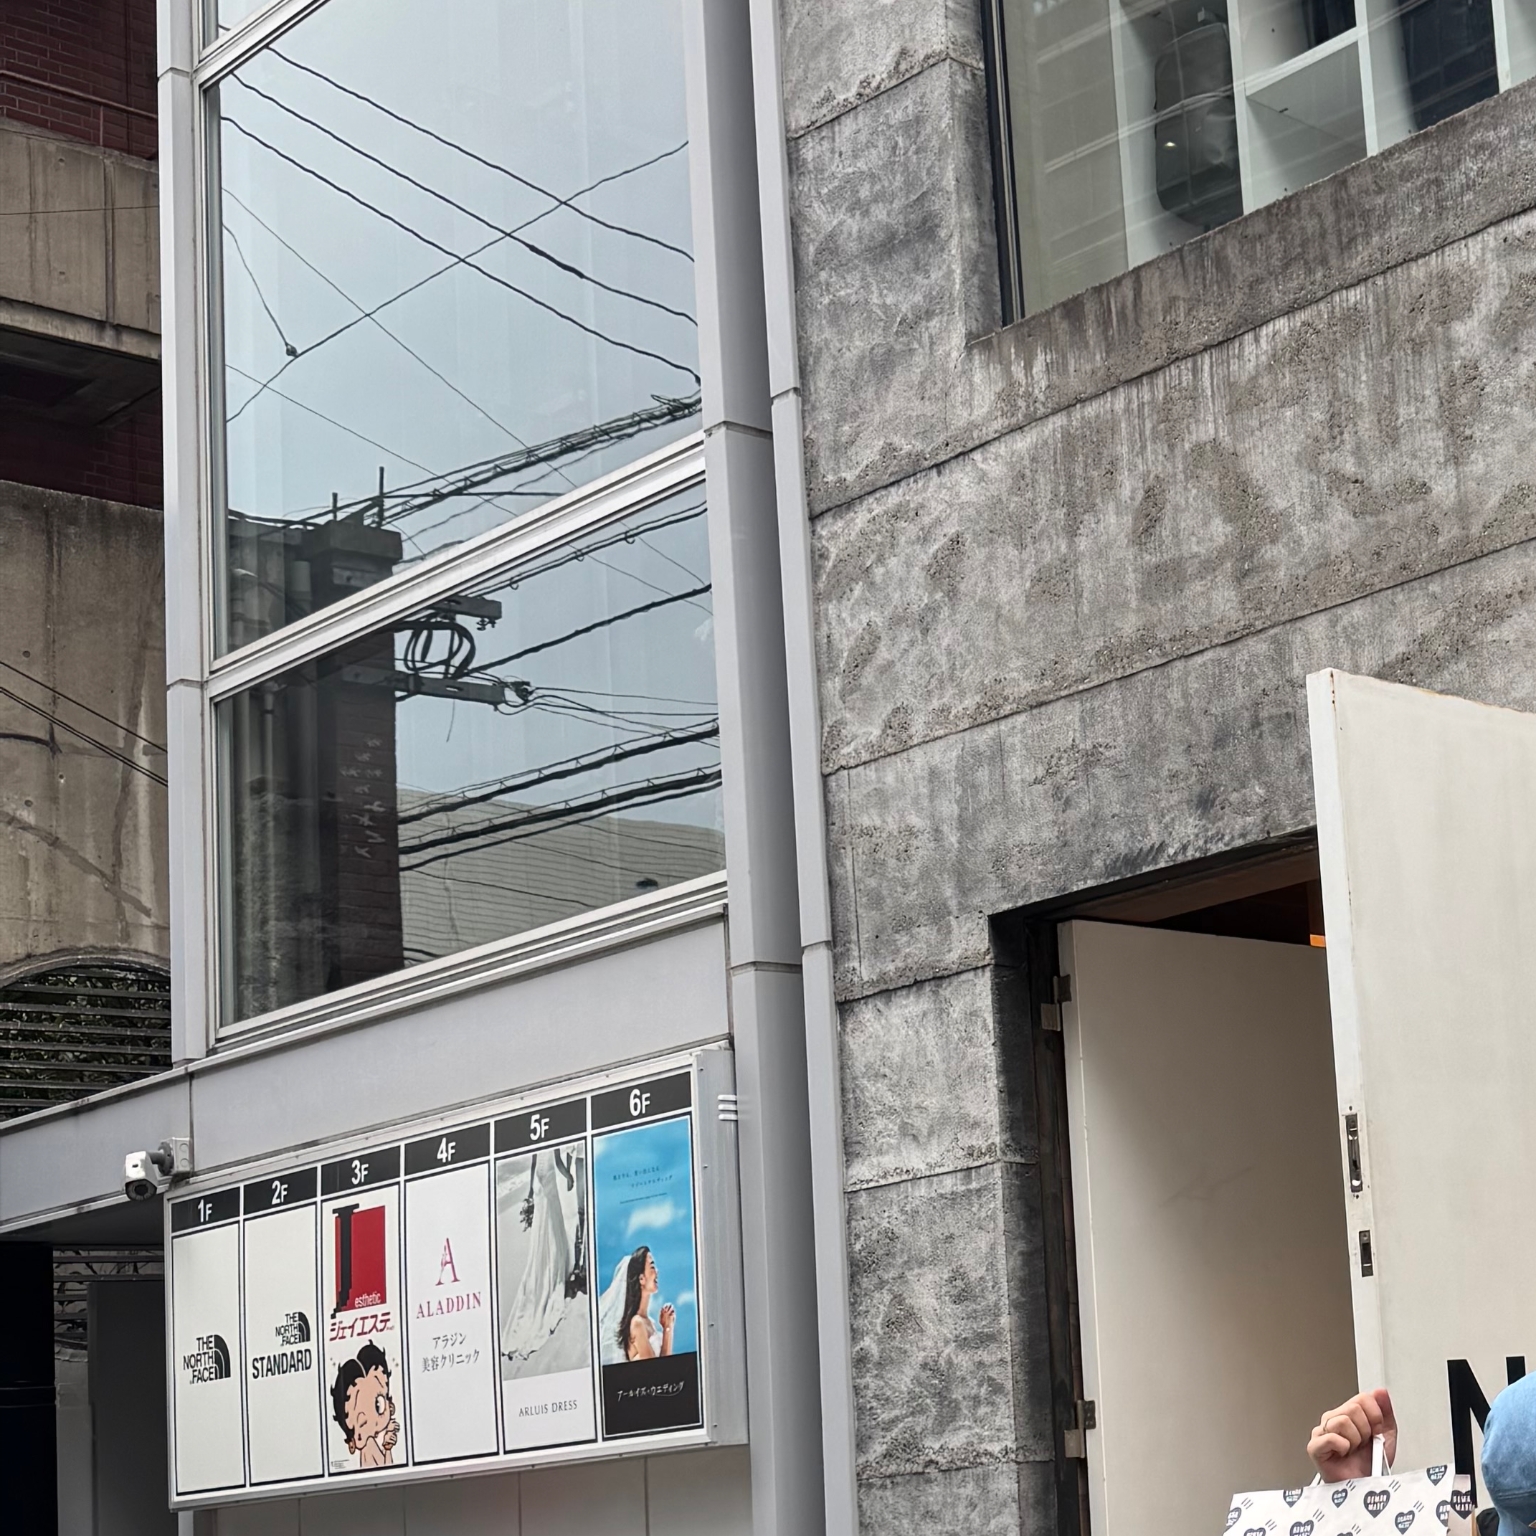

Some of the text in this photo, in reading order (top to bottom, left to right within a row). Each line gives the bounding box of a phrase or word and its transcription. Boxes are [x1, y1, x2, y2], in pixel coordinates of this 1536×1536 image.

[629, 1089, 651, 1116] 6F
[529, 1114, 549, 1140] 5F
[436, 1138, 456, 1164] 4F
[351, 1159, 369, 1185] 3F
[271, 1180, 288, 1205] 2F
[197, 1198, 213, 1223] 1F
[354, 1291, 381, 1308] esthetic
[416, 1291, 482, 1319] ALADDIN
[285, 1312, 299, 1323] THE
[275, 1322, 299, 1337] NORTH
[281, 1333, 300, 1347] FACE
[432, 1332, 467, 1350] アラジン
[196, 1334, 214, 1351] THE
[183, 1350, 214, 1371] NORTH
[252, 1348, 313, 1380] STANDARD
[421, 1349, 480, 1374] 美容クリニック
[190, 1366, 216, 1385] FACE
[518, 1400, 578, 1417] ARLUIS DRESS
